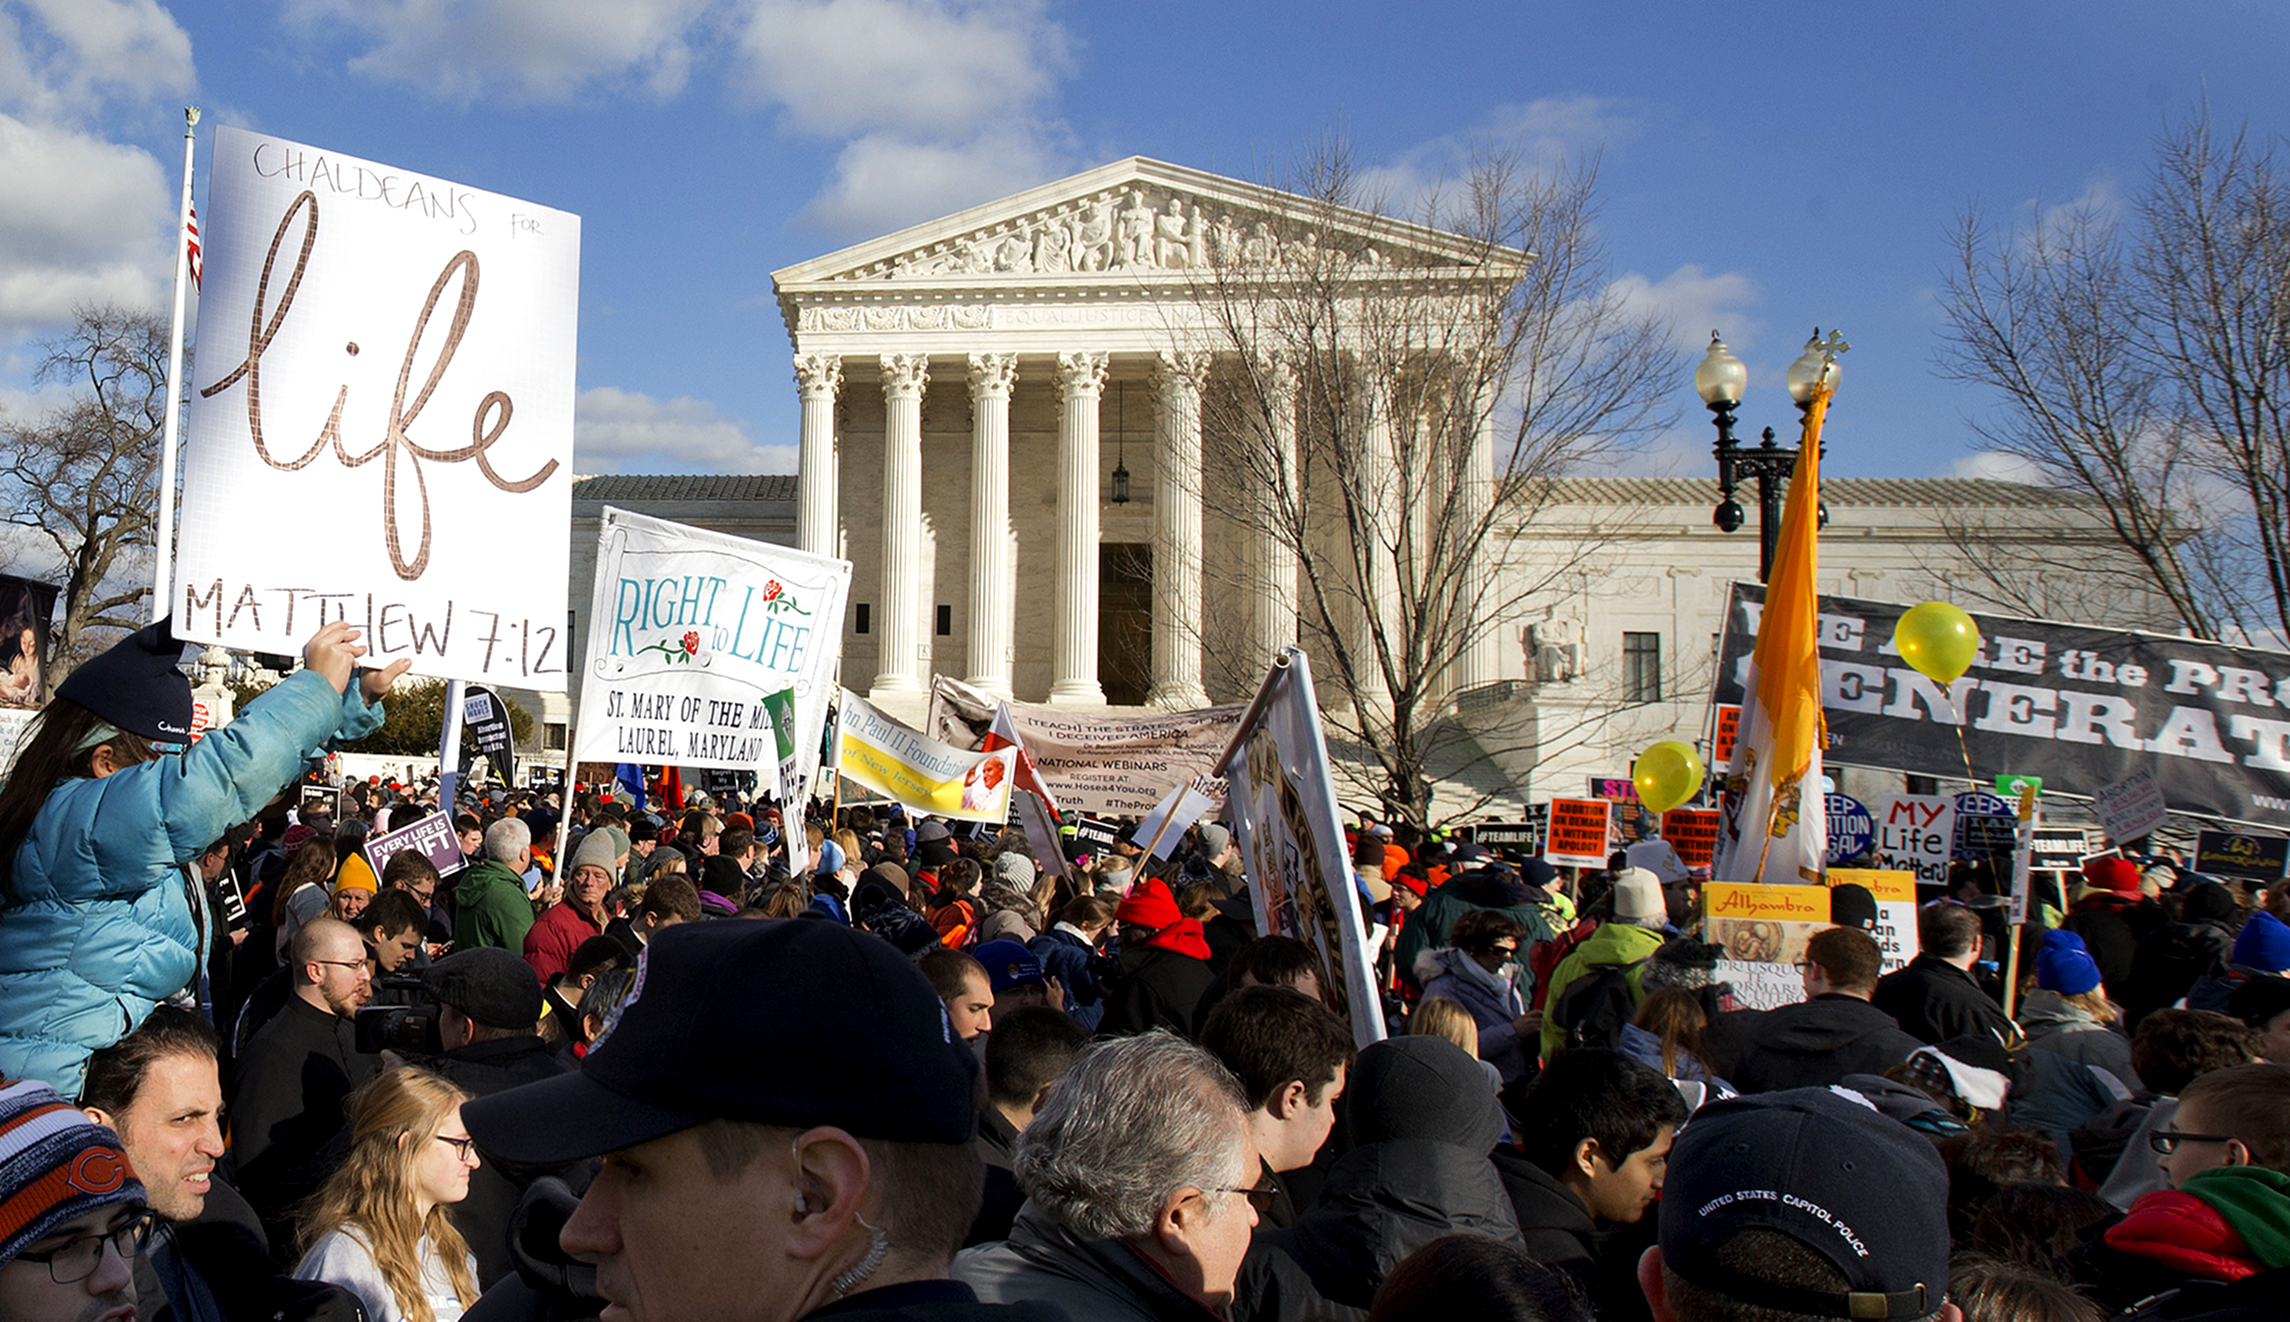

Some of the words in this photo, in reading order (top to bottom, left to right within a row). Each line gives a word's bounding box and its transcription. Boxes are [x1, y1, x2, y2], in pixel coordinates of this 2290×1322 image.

[254, 142, 477, 235] CHALDEANS
[511, 212, 544, 237] FOR
[200, 190, 560, 582] life
[185, 577, 452, 658] MATTHEW
[470, 609, 563, 678] 7:12
[610, 575, 727, 658] RIGHT
[711, 623, 729, 651] to
[729, 584, 811, 673] LIFE
[2059, 649, 2149, 688] the
[607, 690, 624, 718] ST.
[630, 692, 675, 722] MARY
[681, 696, 701, 723] OF
[708, 700, 743, 728] THE
[748, 704, 776, 730] MIL
[1733, 649, 2290, 774] ENERAT
[860, 713, 893, 744] Paul
[1056, 731, 1126, 741] DECEIVED
[1129, 728, 1189, 740] AMERICA
[1085, 725, 1112, 733] THE
[617, 726, 680, 761] LAUREL,
[687, 732, 763, 762] MARYLAND
[843, 747, 855, 759] of
[859, 753, 890, 776] New
[892, 769, 934, 798] Jersey
[1037, 757, 1099, 769] NATIONAL
[1102, 759, 1168, 772] WEBINARS
[1069, 772, 1116, 782] REGISTER
[1055, 796, 1084, 806] Truth
[1558, 803, 1606, 816] ABORTION
[1888, 800, 1947, 829] MY
[1552, 828, 1562, 838] &
[1563, 829, 1606, 841] WITHOUT
[1553, 814, 1567, 826] ON
[1568, 817, 1606, 828] DEMAND
[1665, 824, 1680, 836] ON
[1681, 826, 1717, 838] DEMAN
[372, 832, 411, 858] EVERY
[410, 823, 435, 841] LIFE
[434, 818, 447, 832] IS
[401, 828, 450, 858] IFT
[1477, 831, 1534, 843] #TEAMLIFE
[1556, 840, 1599, 852] APOLOGY
[1826, 834, 1864, 856] GAL
[1881, 826, 1943, 855] Life
[1714, 889, 1815, 916] Alhambra
[1879, 909, 1889, 920] a
[1875, 925, 1895, 936] an
[1883, 958, 1905, 970] wn
[1698, 1194, 1734, 1217] UNITED
[1736, 1189, 1778, 1201] STATES
[1782, 1193, 1832, 1224] CAPITOL
[1833, 1219, 1870, 1259] POLICE
